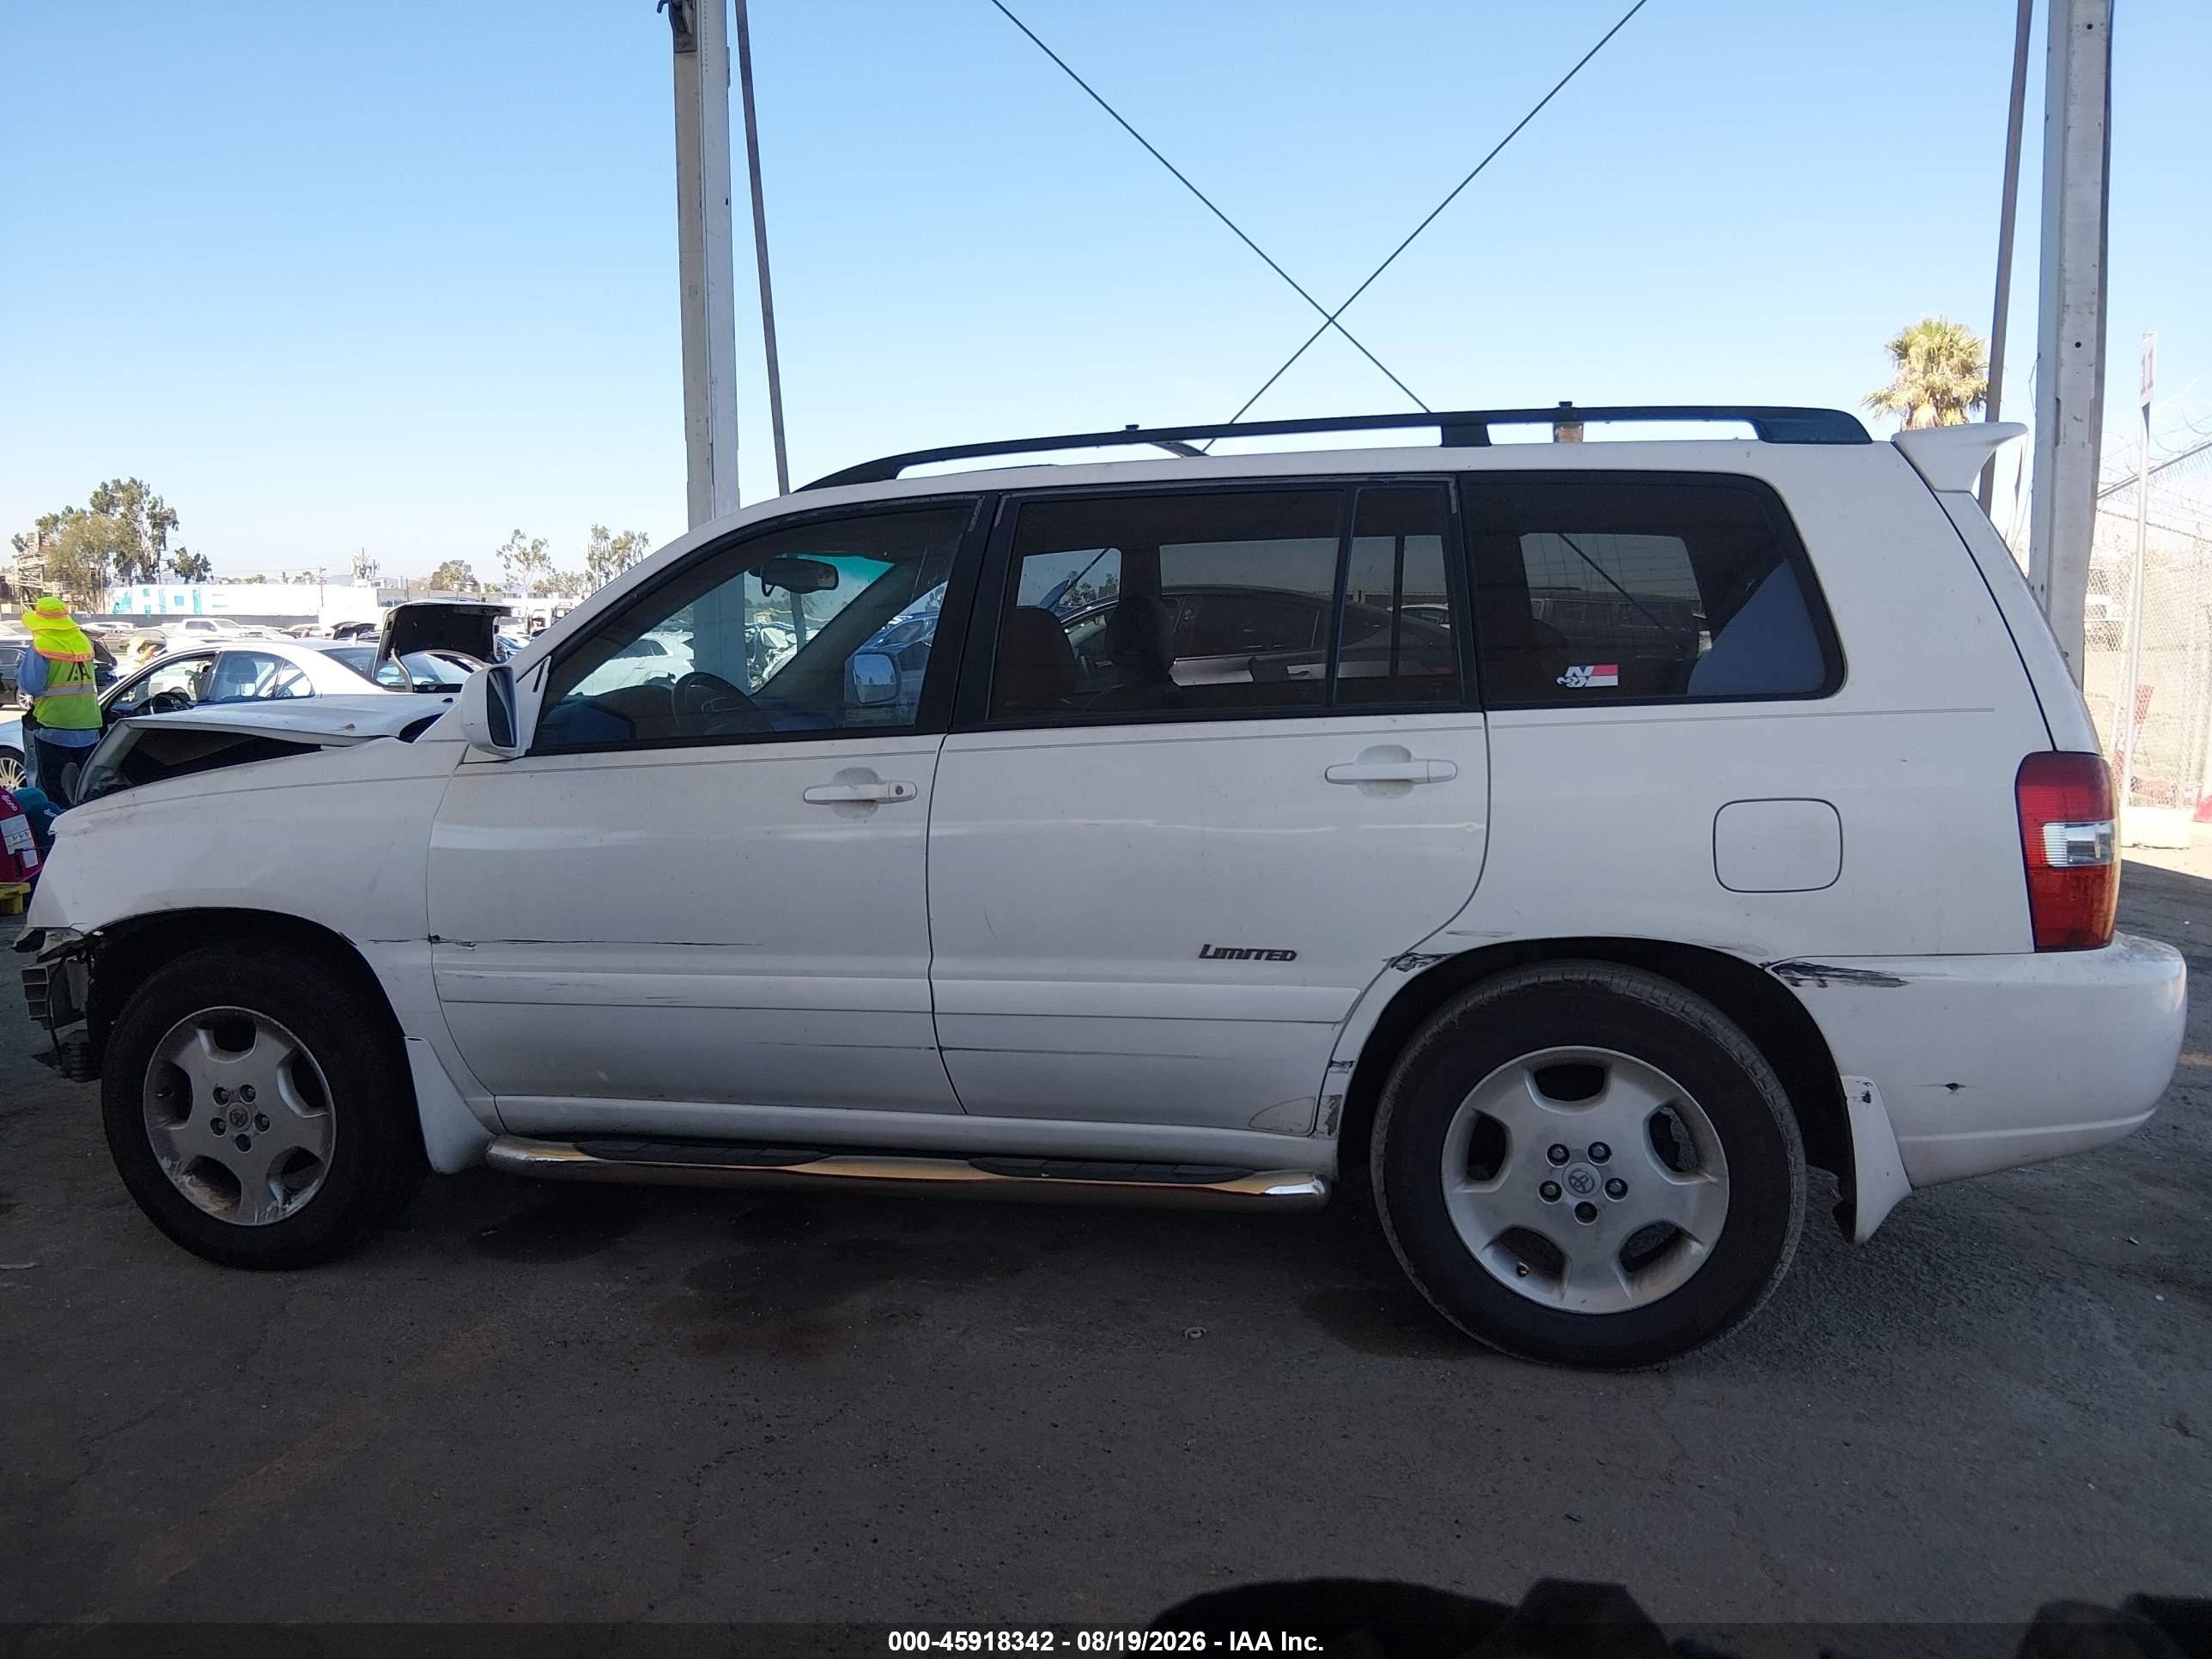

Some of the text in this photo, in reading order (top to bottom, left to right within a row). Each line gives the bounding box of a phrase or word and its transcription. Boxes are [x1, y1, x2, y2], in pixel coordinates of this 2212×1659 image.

[1, 793, 19, 812] diono
[43, 807, 58, 818] dion
[1198, 944, 1298, 963] LIMITED
